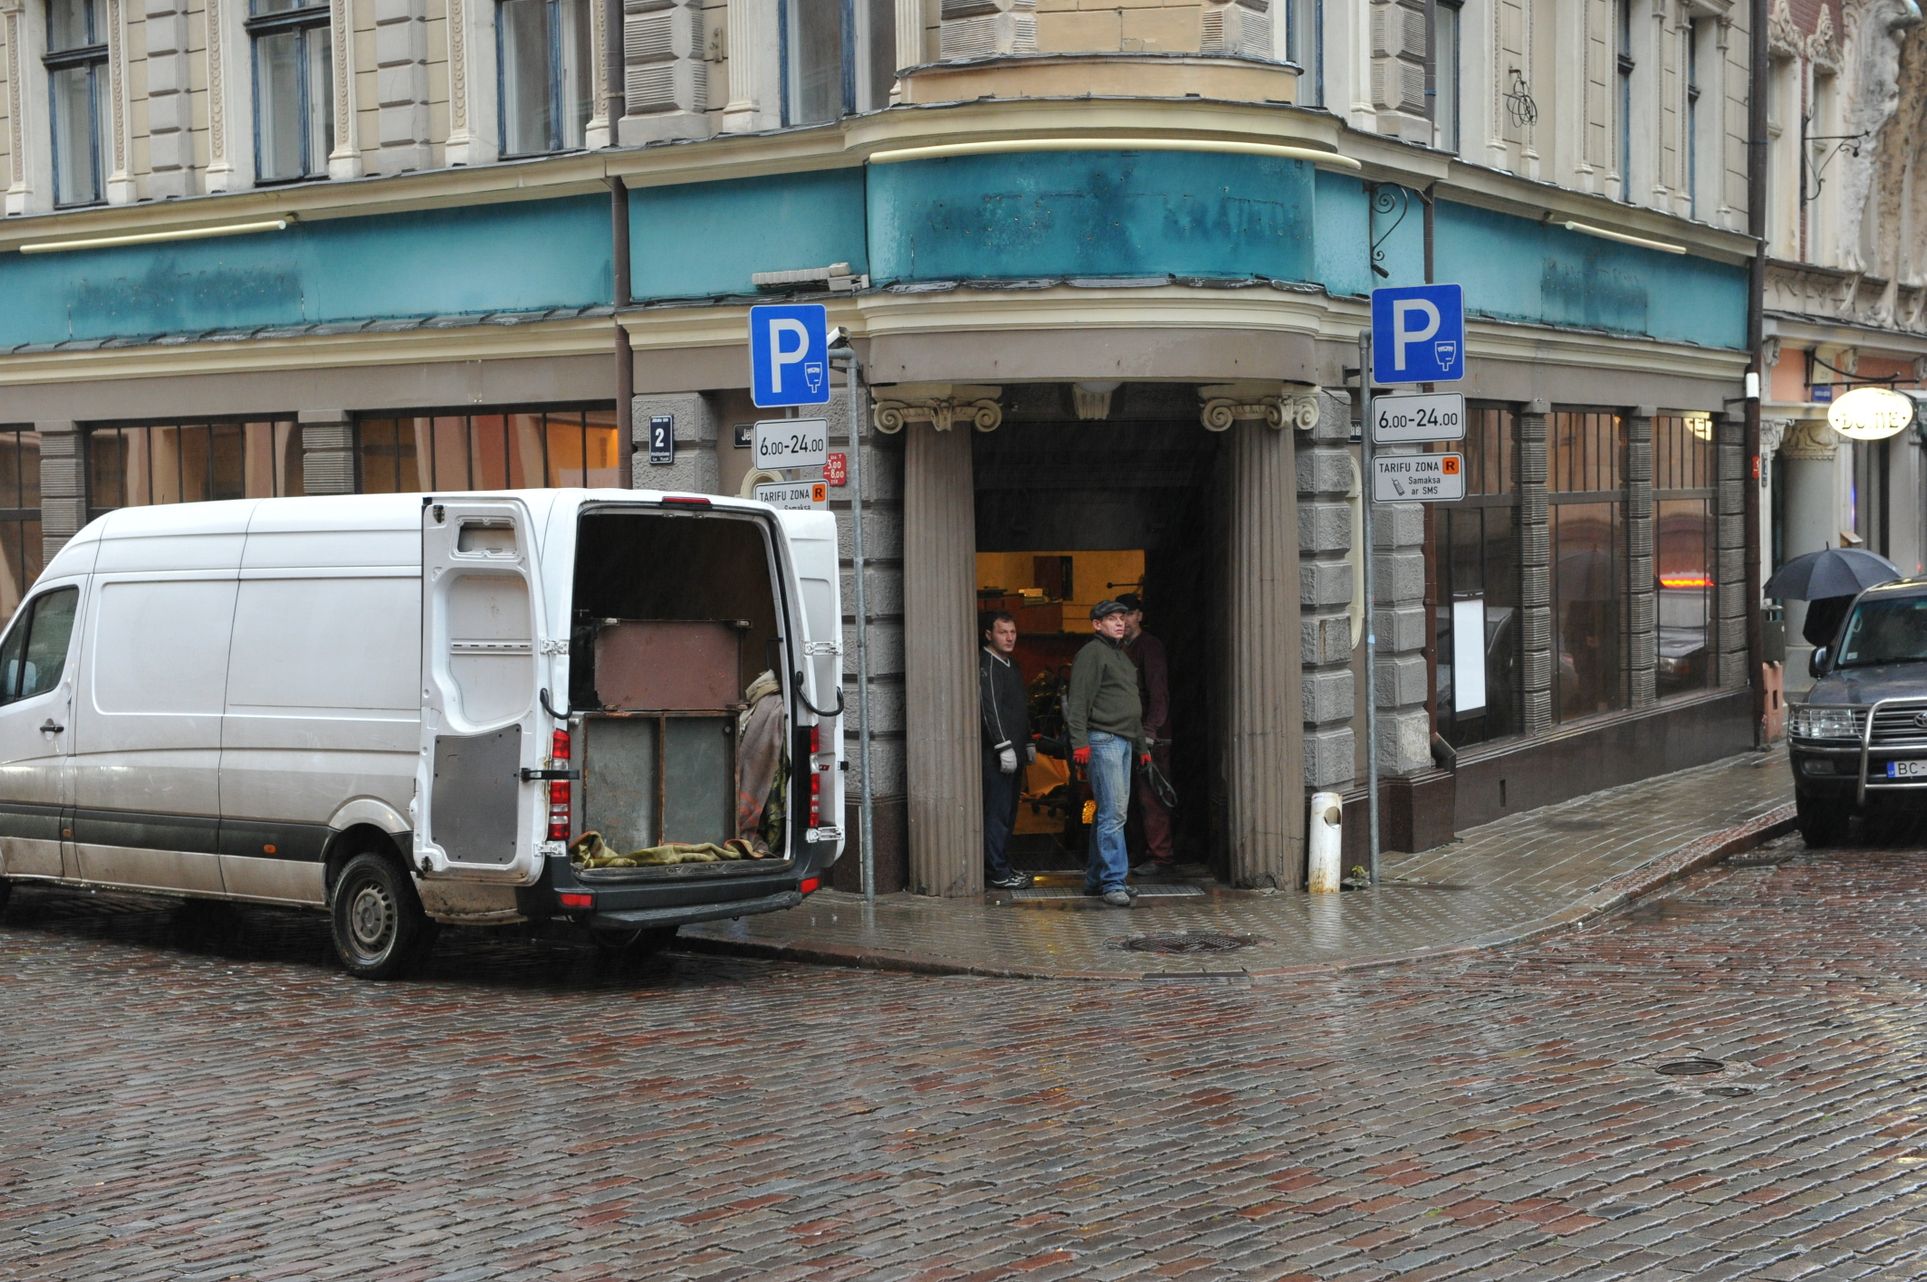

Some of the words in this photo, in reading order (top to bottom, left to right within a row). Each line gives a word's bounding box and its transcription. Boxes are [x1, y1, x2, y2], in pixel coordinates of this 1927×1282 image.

[1393, 298, 1441, 371] P
[769, 318, 810, 393] P
[1379, 408, 1458, 429] 6.00-24.00
[655, 428, 665, 447] 2
[760, 434, 824, 456] 6.00-24.00
[1379, 462, 1411, 473] TARIFU
[1415, 461, 1440, 472] ZONA
[1446, 460, 1456, 471] R
[1408, 476, 1441, 485] Samaksa
[760, 491, 787, 502] TARIFU
[790, 489, 810, 500] ZONA
[815, 488, 823, 498] R
[1422, 486, 1438, 495] SMS
